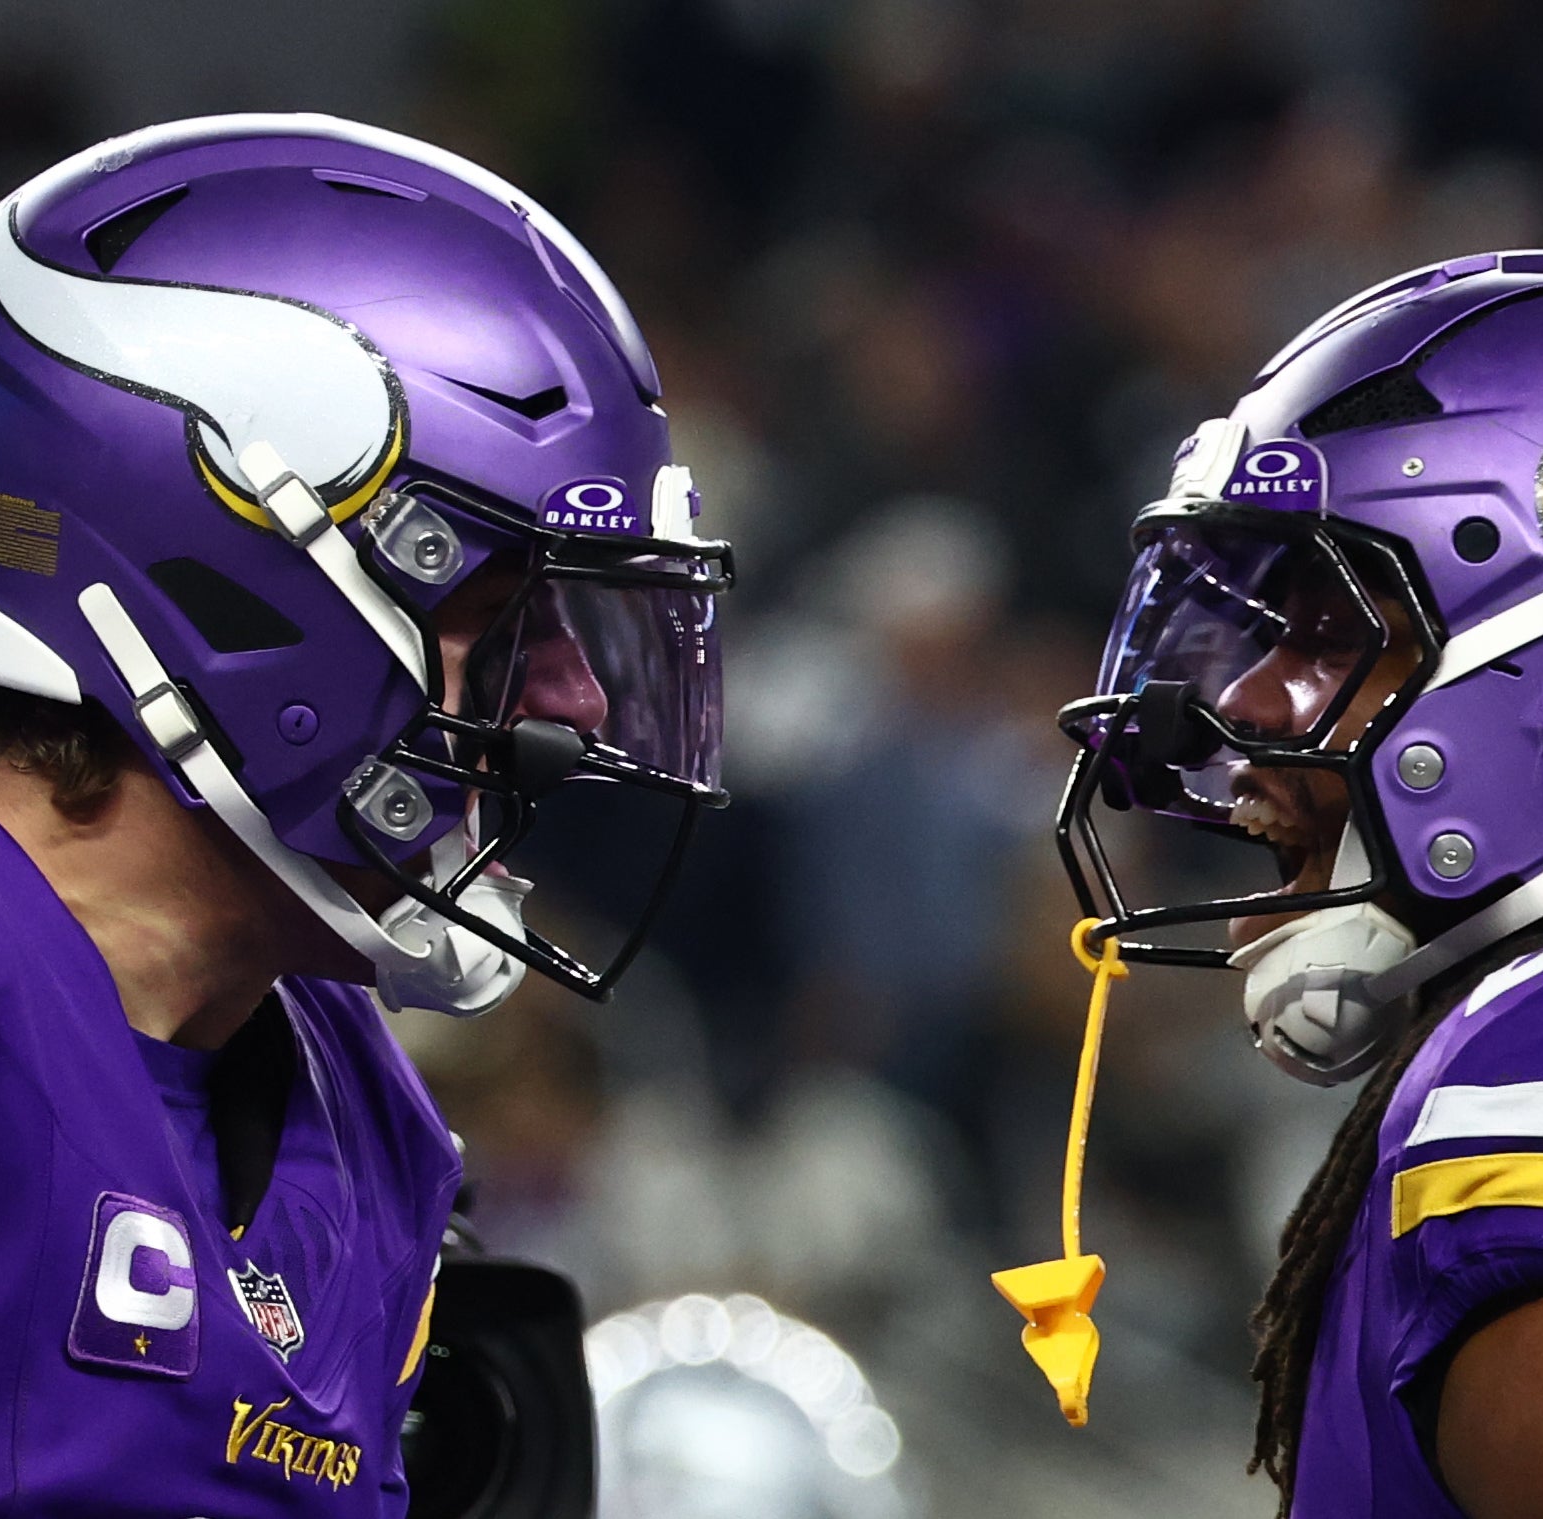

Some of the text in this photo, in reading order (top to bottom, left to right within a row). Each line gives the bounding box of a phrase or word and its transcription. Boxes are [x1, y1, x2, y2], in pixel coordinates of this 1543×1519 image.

[1230, 478, 1314, 496] OAKLEY
[545, 510, 634, 530] OAKLEY
[95, 1210, 195, 1331] C
[251, 1301, 299, 1342] NFL
